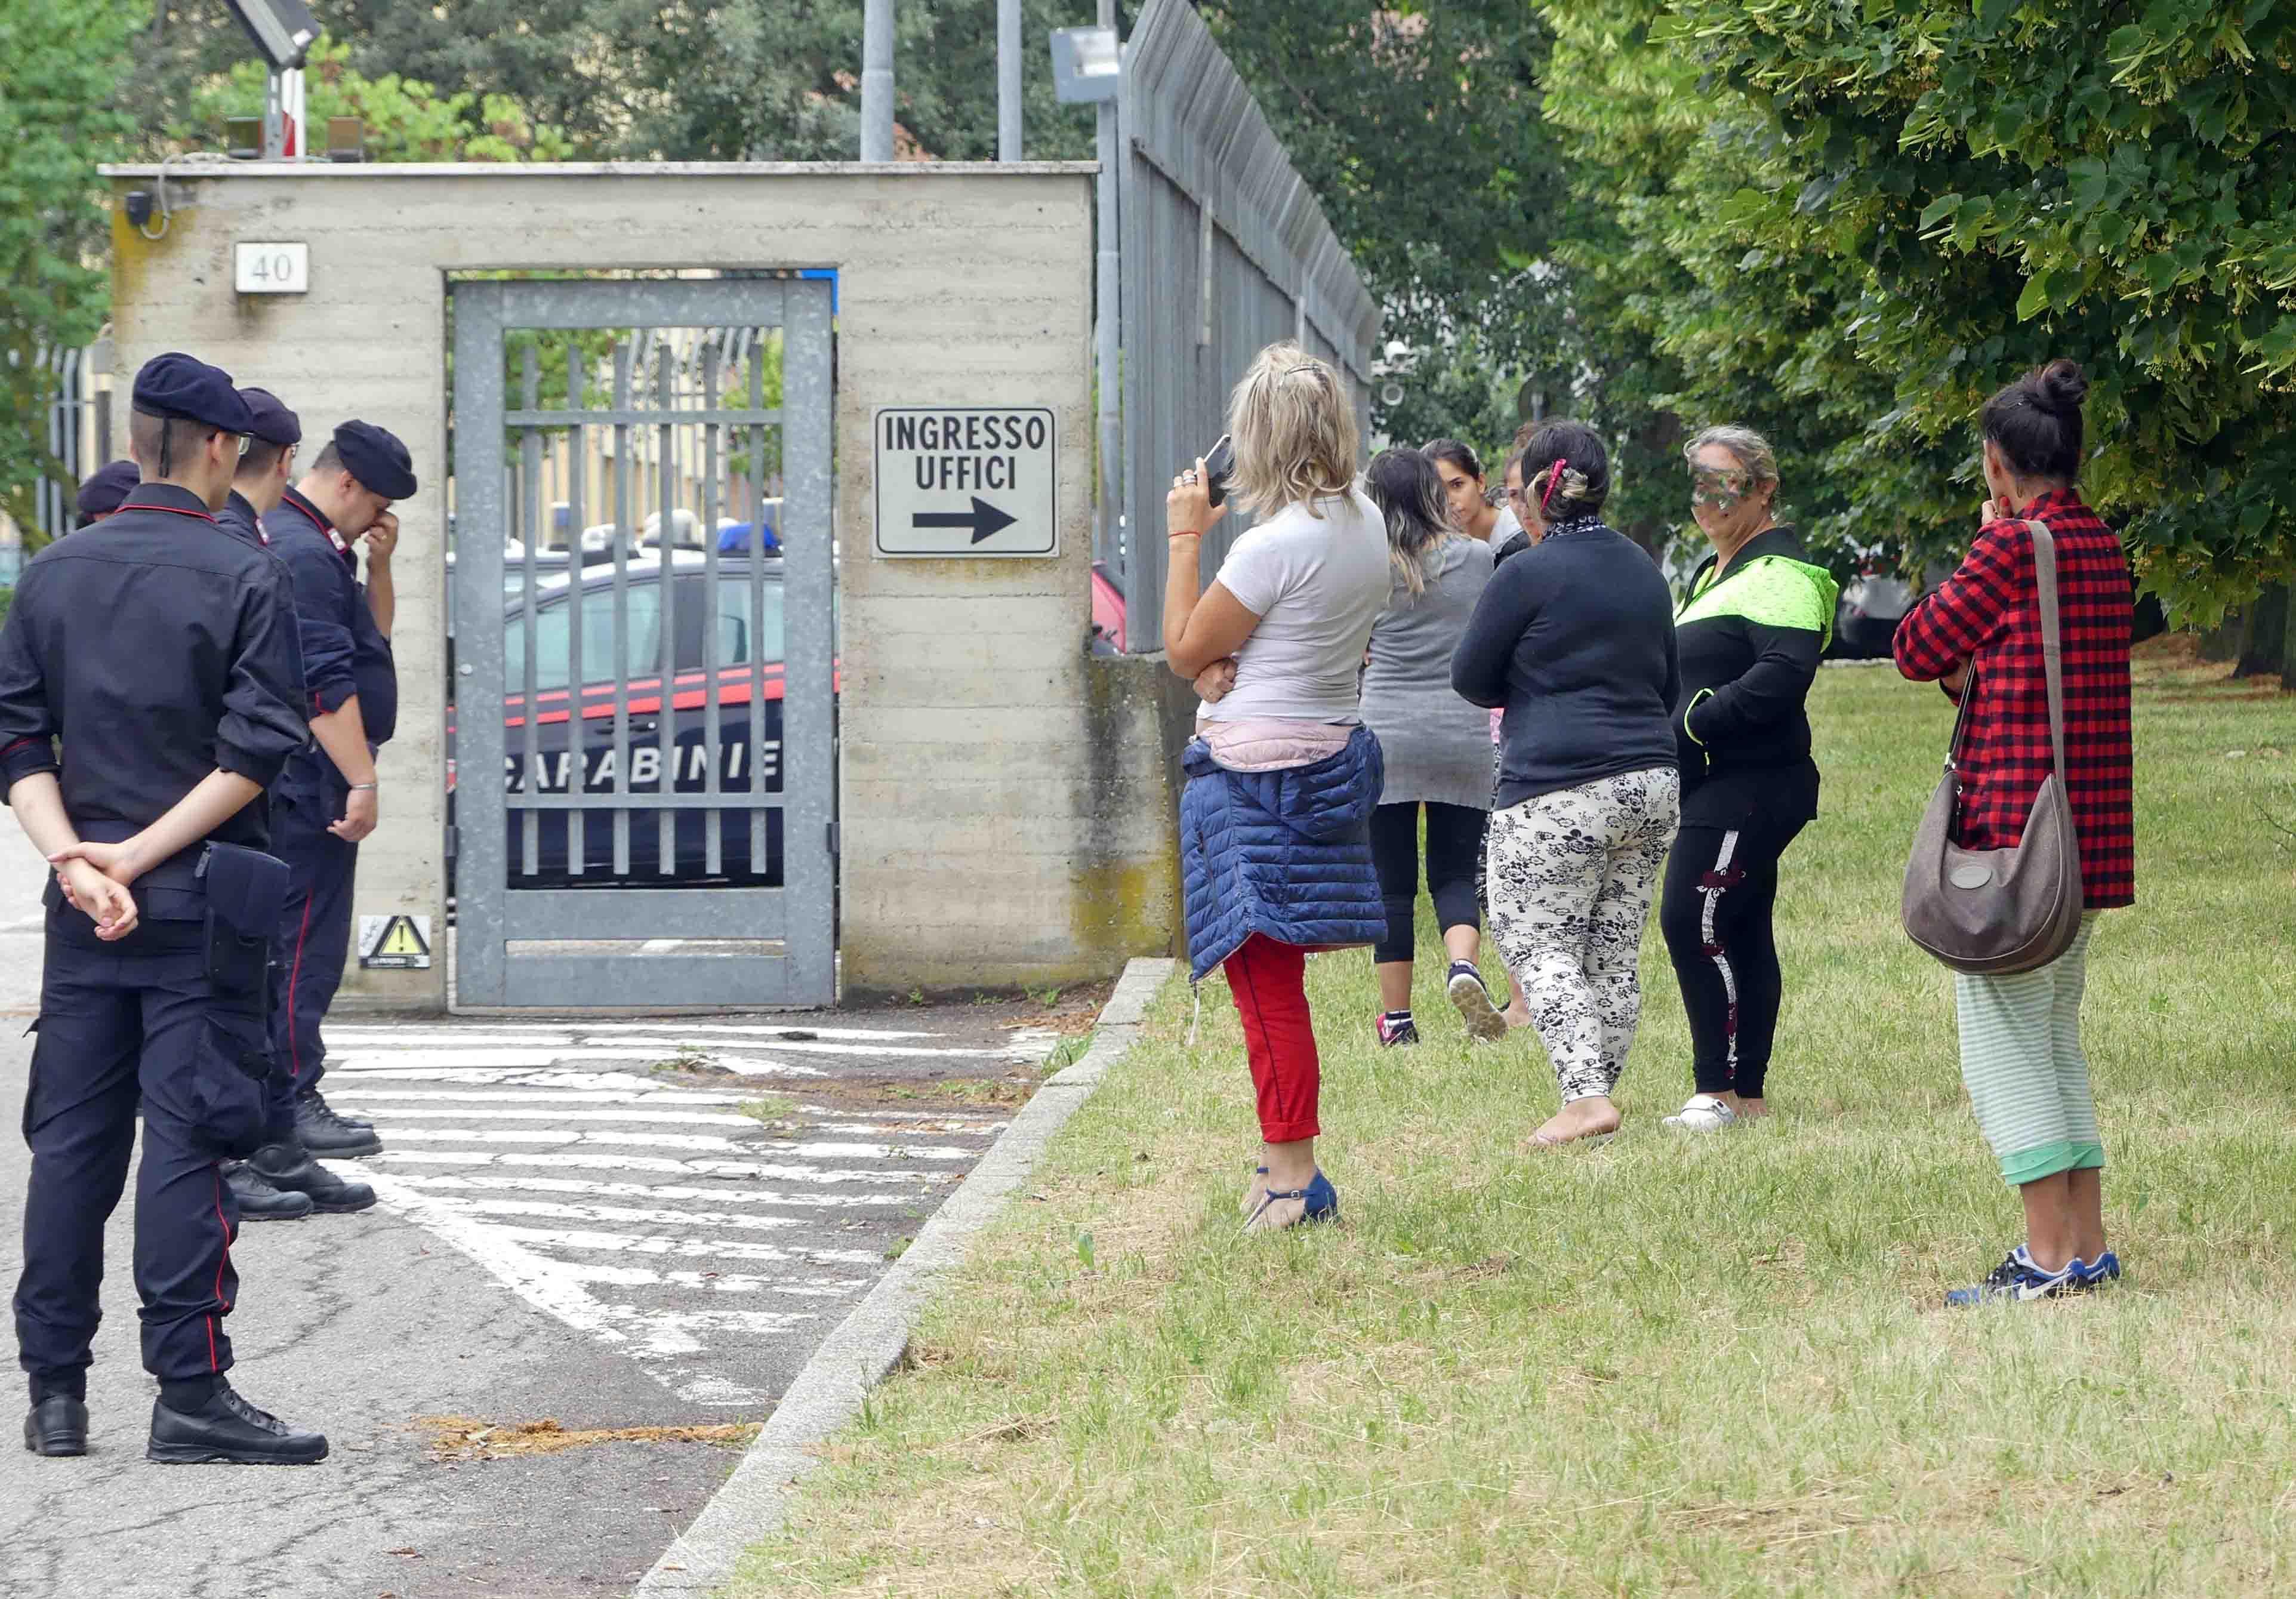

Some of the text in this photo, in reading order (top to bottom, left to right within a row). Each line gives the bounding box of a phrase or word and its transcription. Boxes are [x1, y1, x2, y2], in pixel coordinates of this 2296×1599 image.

[251, 254, 292, 282] 40
[886, 416, 1046, 450] INGRESSO
[916, 456, 1016, 490] UFFICI
